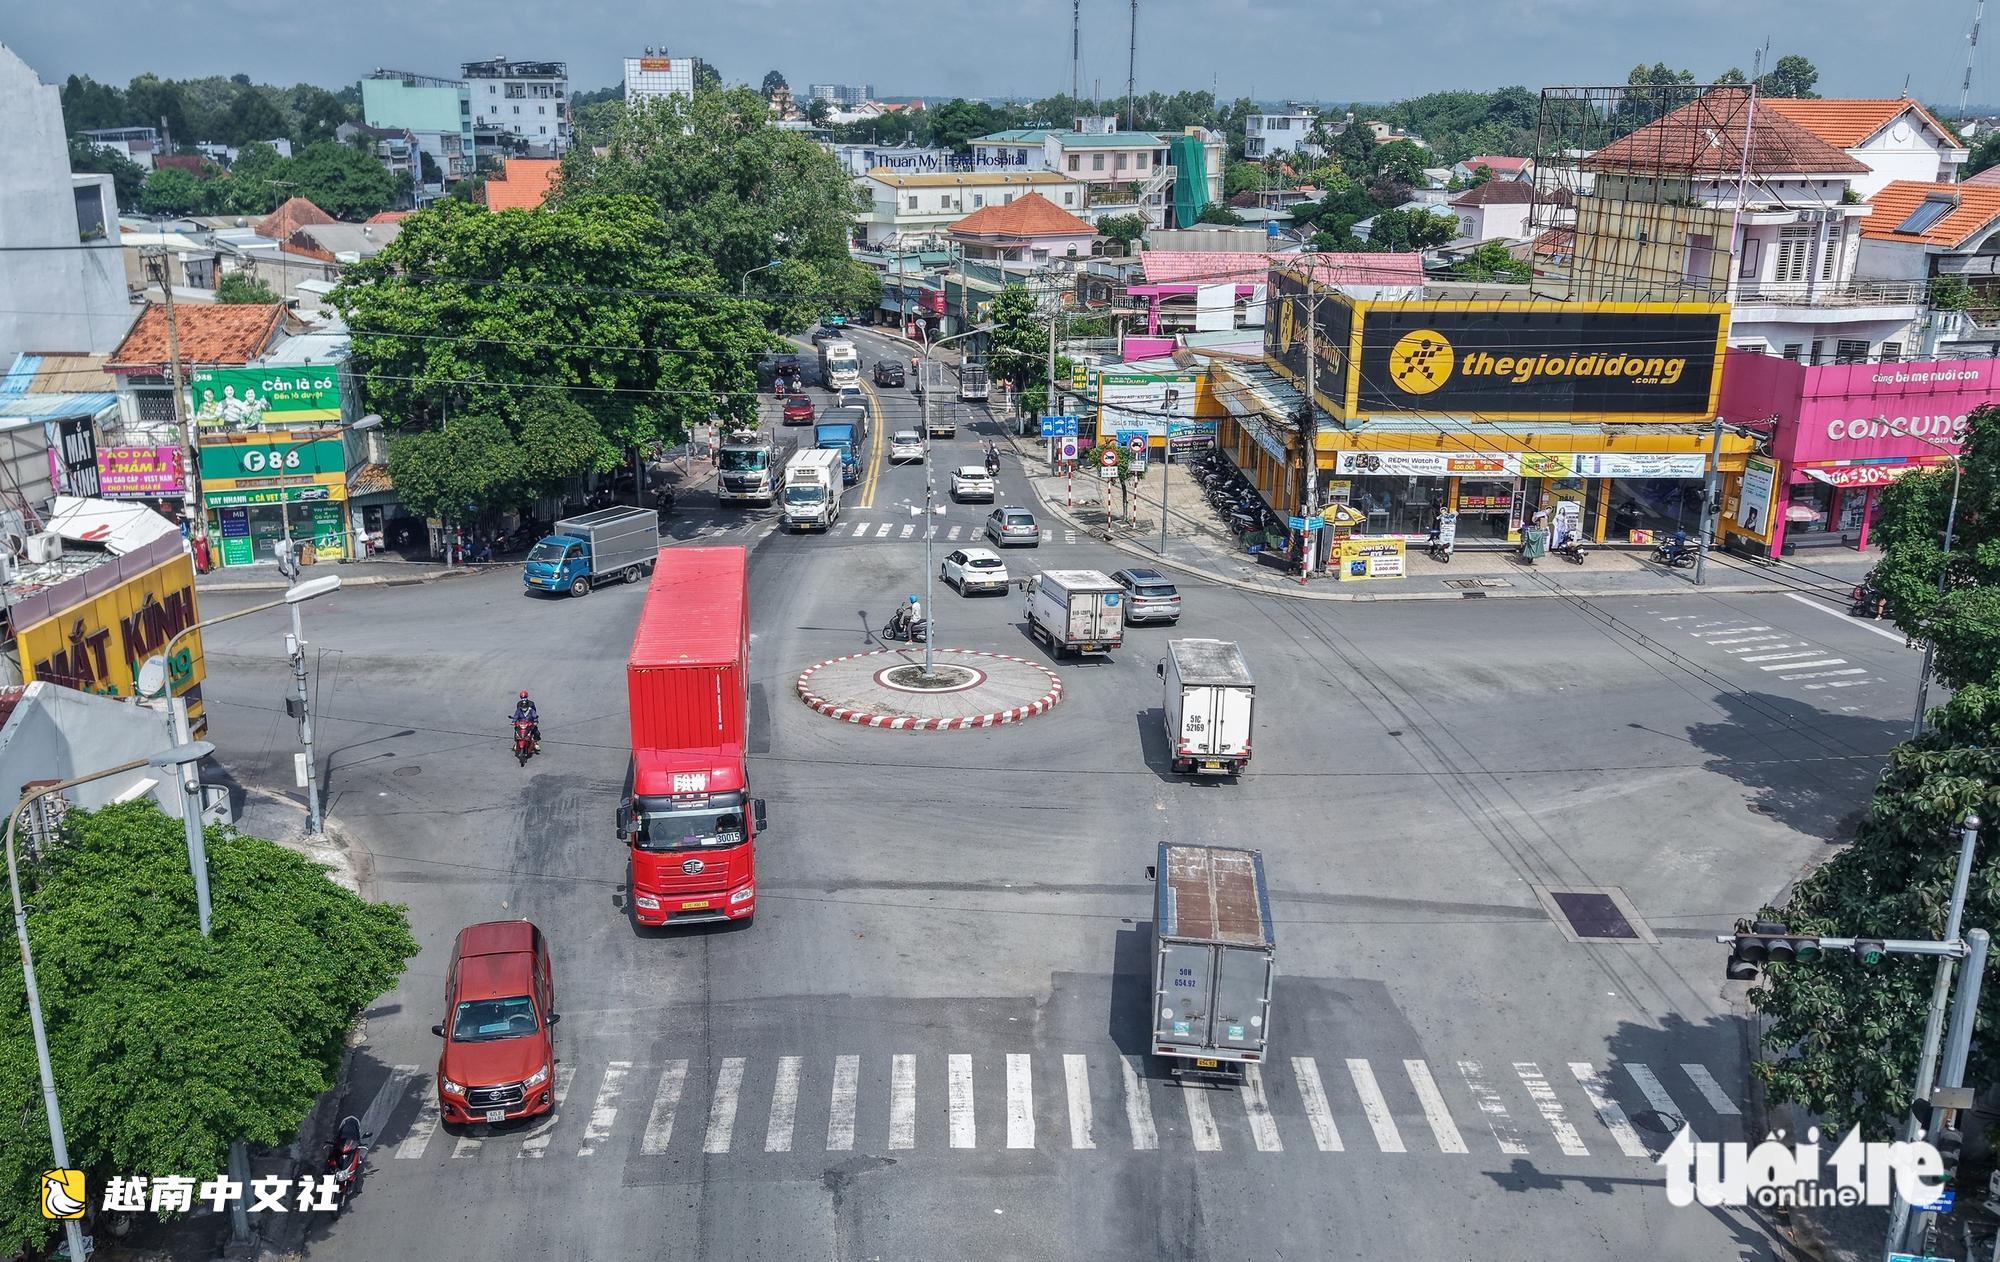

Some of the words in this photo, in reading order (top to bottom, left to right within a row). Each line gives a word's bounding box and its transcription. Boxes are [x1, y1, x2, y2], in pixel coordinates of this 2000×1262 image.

[875, 154, 916, 168] Thuan
[919, 154, 938, 169] My
[976, 153, 1028, 168] Hospital
[1461, 352, 1686, 385] thegioididong
[261, 375, 293, 392] Cần
[296, 377, 311, 390] là
[313, 376, 332, 389] có
[1631, 377, 1659, 385] .com
[1872, 374, 1893, 384] Cùng
[1895, 371, 1909, 382] ba
[1911, 371, 1929, 385] mẹ
[1931, 369, 1956, 381] nuôi
[1957, 371, 1979, 380] con
[1826, 414, 1968, 445] concung
[34, 616, 111, 692] MẮT
[120, 585, 197, 666] KÍNH
[1189, 714, 1202, 723] 51C
[1185, 723, 1205, 732] 52169
[716, 832, 741, 843] 30015
